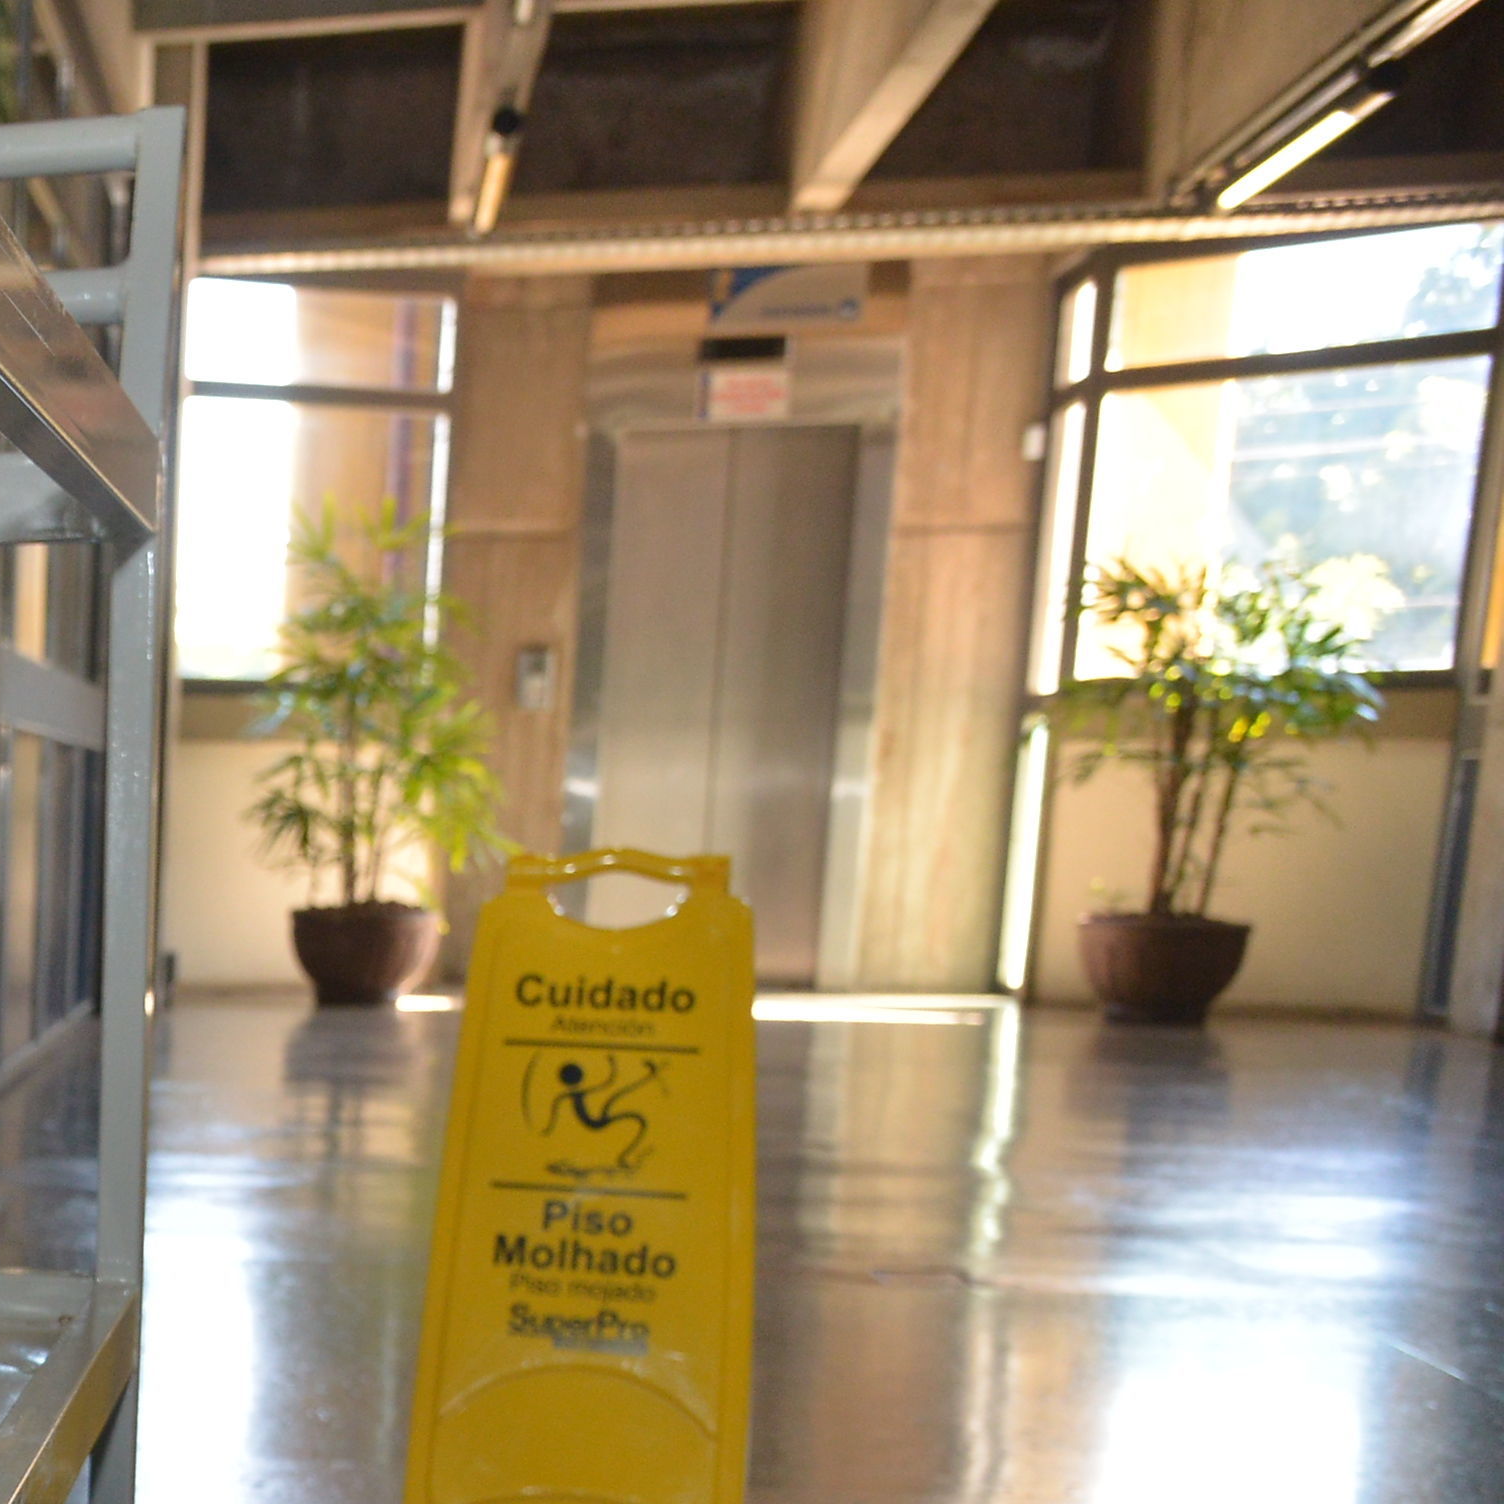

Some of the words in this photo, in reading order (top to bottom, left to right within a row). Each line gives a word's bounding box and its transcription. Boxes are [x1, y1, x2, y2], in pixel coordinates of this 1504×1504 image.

[515, 973, 696, 1014] Cuidado
[543, 1199, 633, 1237] Piso
[493, 1233, 677, 1279] Molhado
